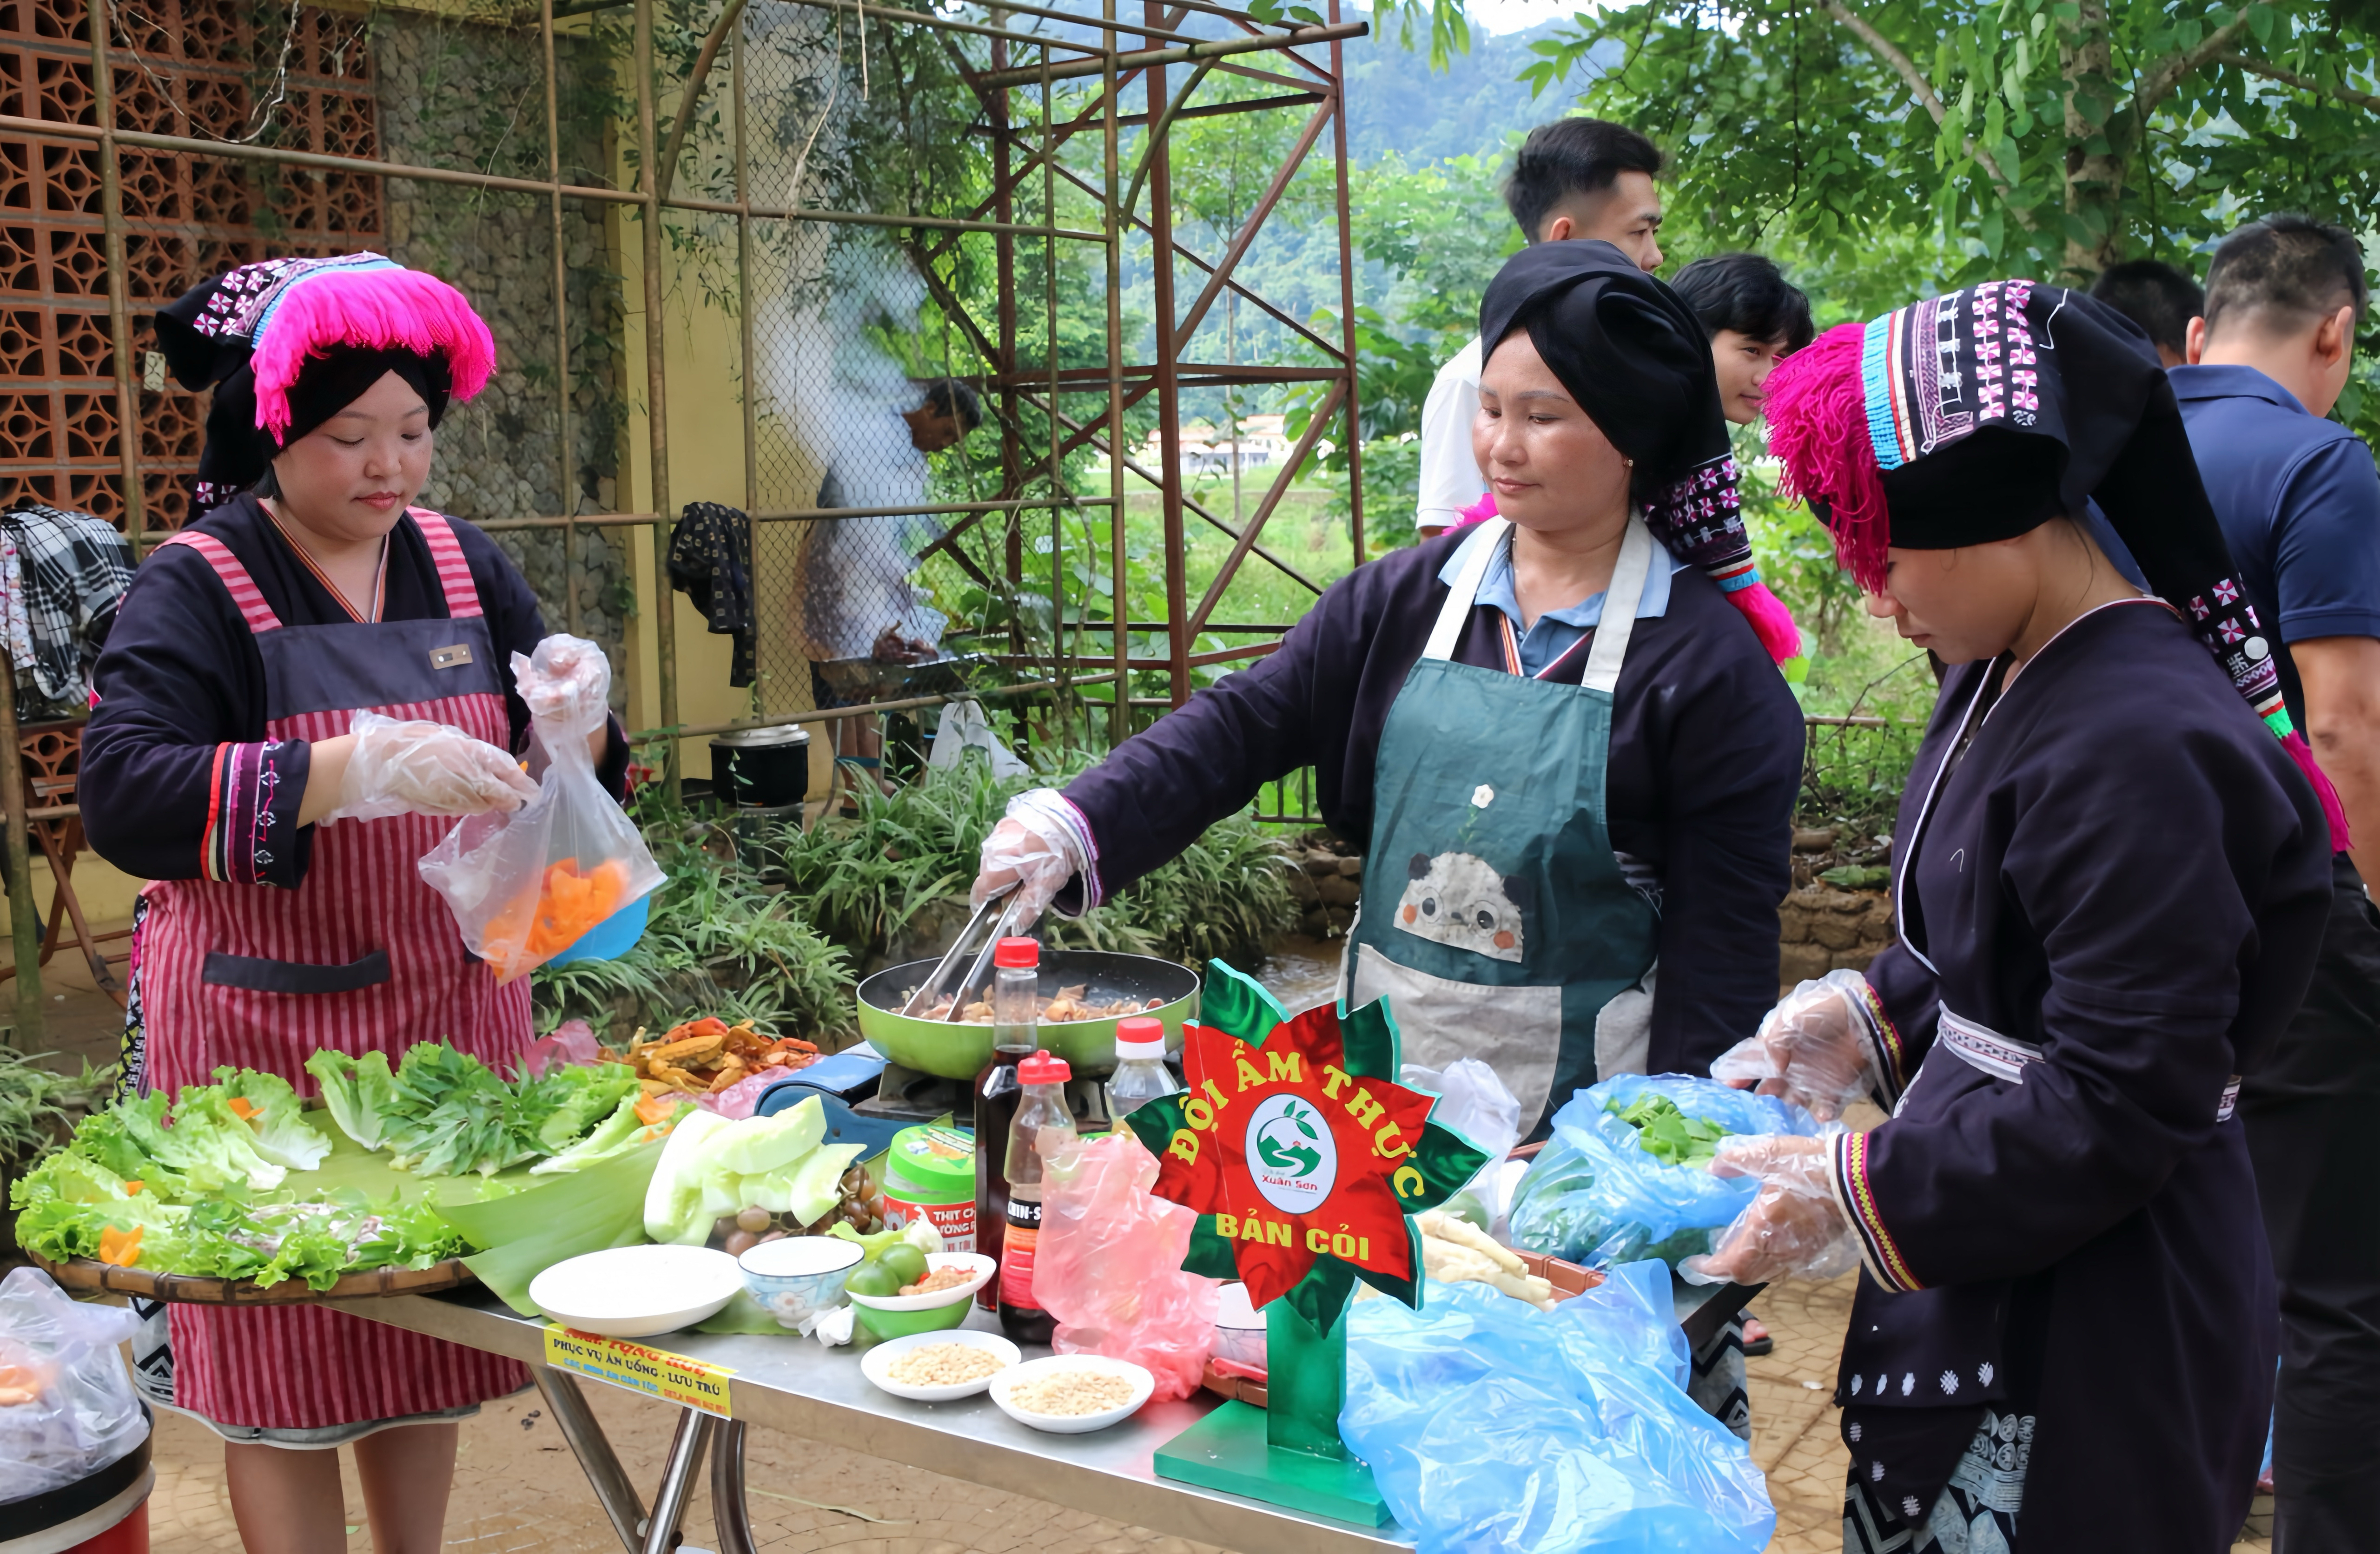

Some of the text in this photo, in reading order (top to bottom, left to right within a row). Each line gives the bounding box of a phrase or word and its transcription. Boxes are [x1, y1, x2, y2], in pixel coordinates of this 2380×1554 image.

[1169, 1039, 1425, 1198] ĐỘI ẨM THỰC
[1262, 1174, 1317, 1191] Xuân Sơn
[1008, 1200, 1041, 1220] CHIN-S
[1216, 1209, 1369, 1261] BẢN CỎI
[554, 1338, 583, 1355] PHỤC
[586, 1348, 602, 1362] VỤ
[626, 1359, 658, 1377] UỐNG
[668, 1372, 692, 1388] LƯU
[695, 1381, 720, 1396] TRÚ
